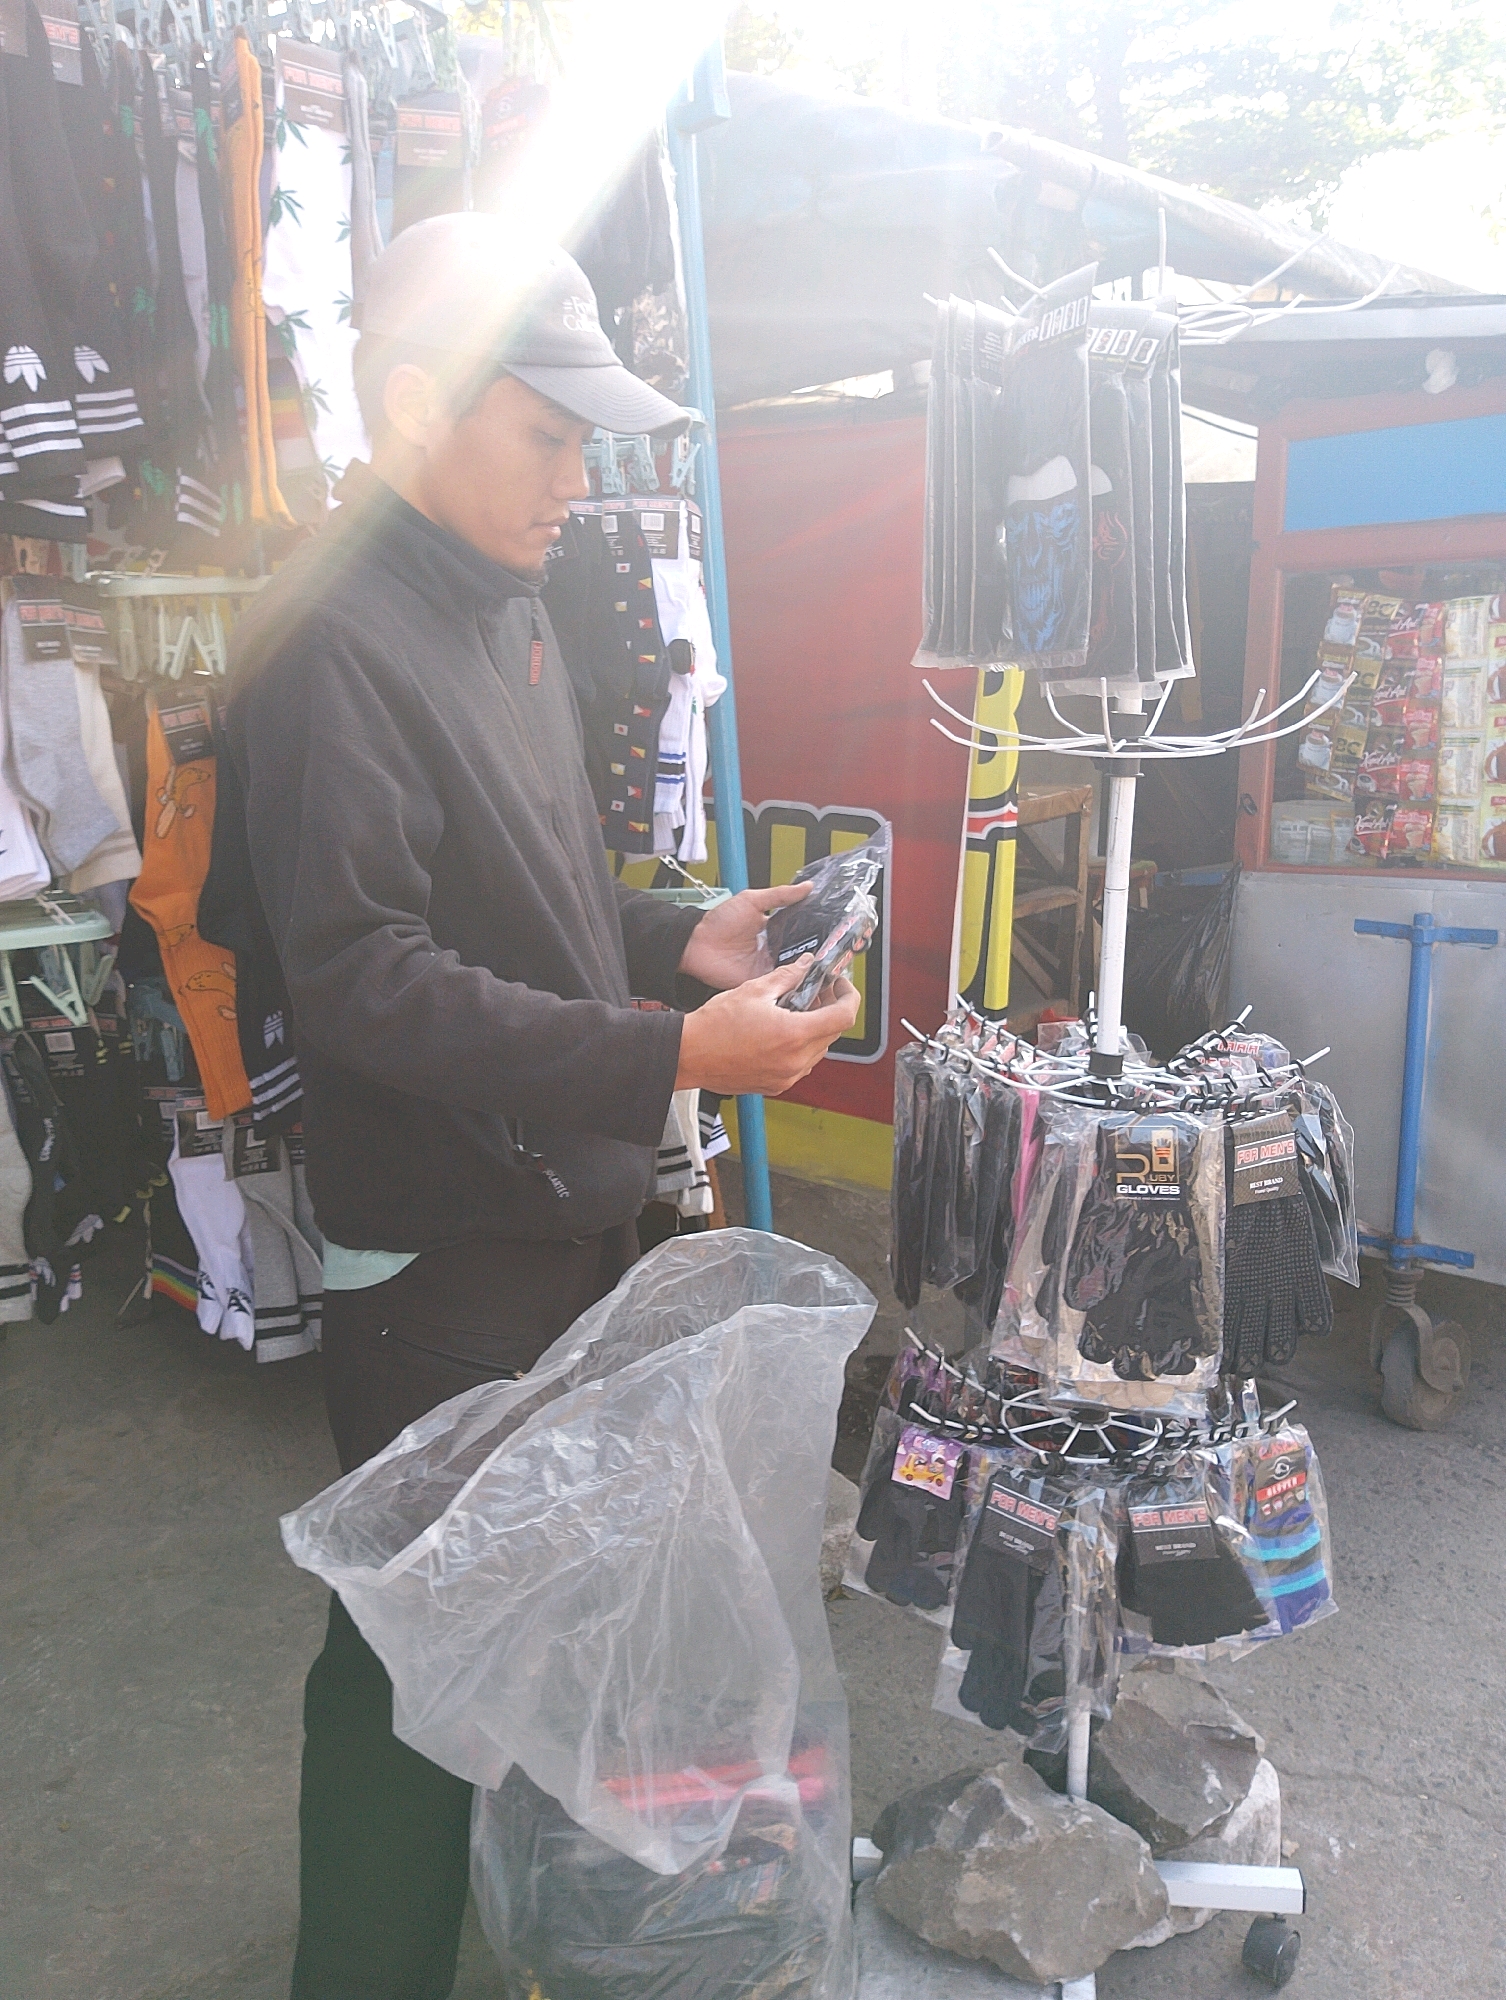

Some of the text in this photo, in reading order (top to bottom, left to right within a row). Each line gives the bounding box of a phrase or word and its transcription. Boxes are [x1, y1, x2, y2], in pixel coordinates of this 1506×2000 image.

[42, 21, 79, 44] EN'S
[1236, 1138, 1295, 1166] FOR MEN'S
[1116, 1184, 1181, 1195] GLOVES
[990, 1489, 1057, 1531] FOR MEN'S
[1132, 1506, 1208, 1528] FOR MEN'S
